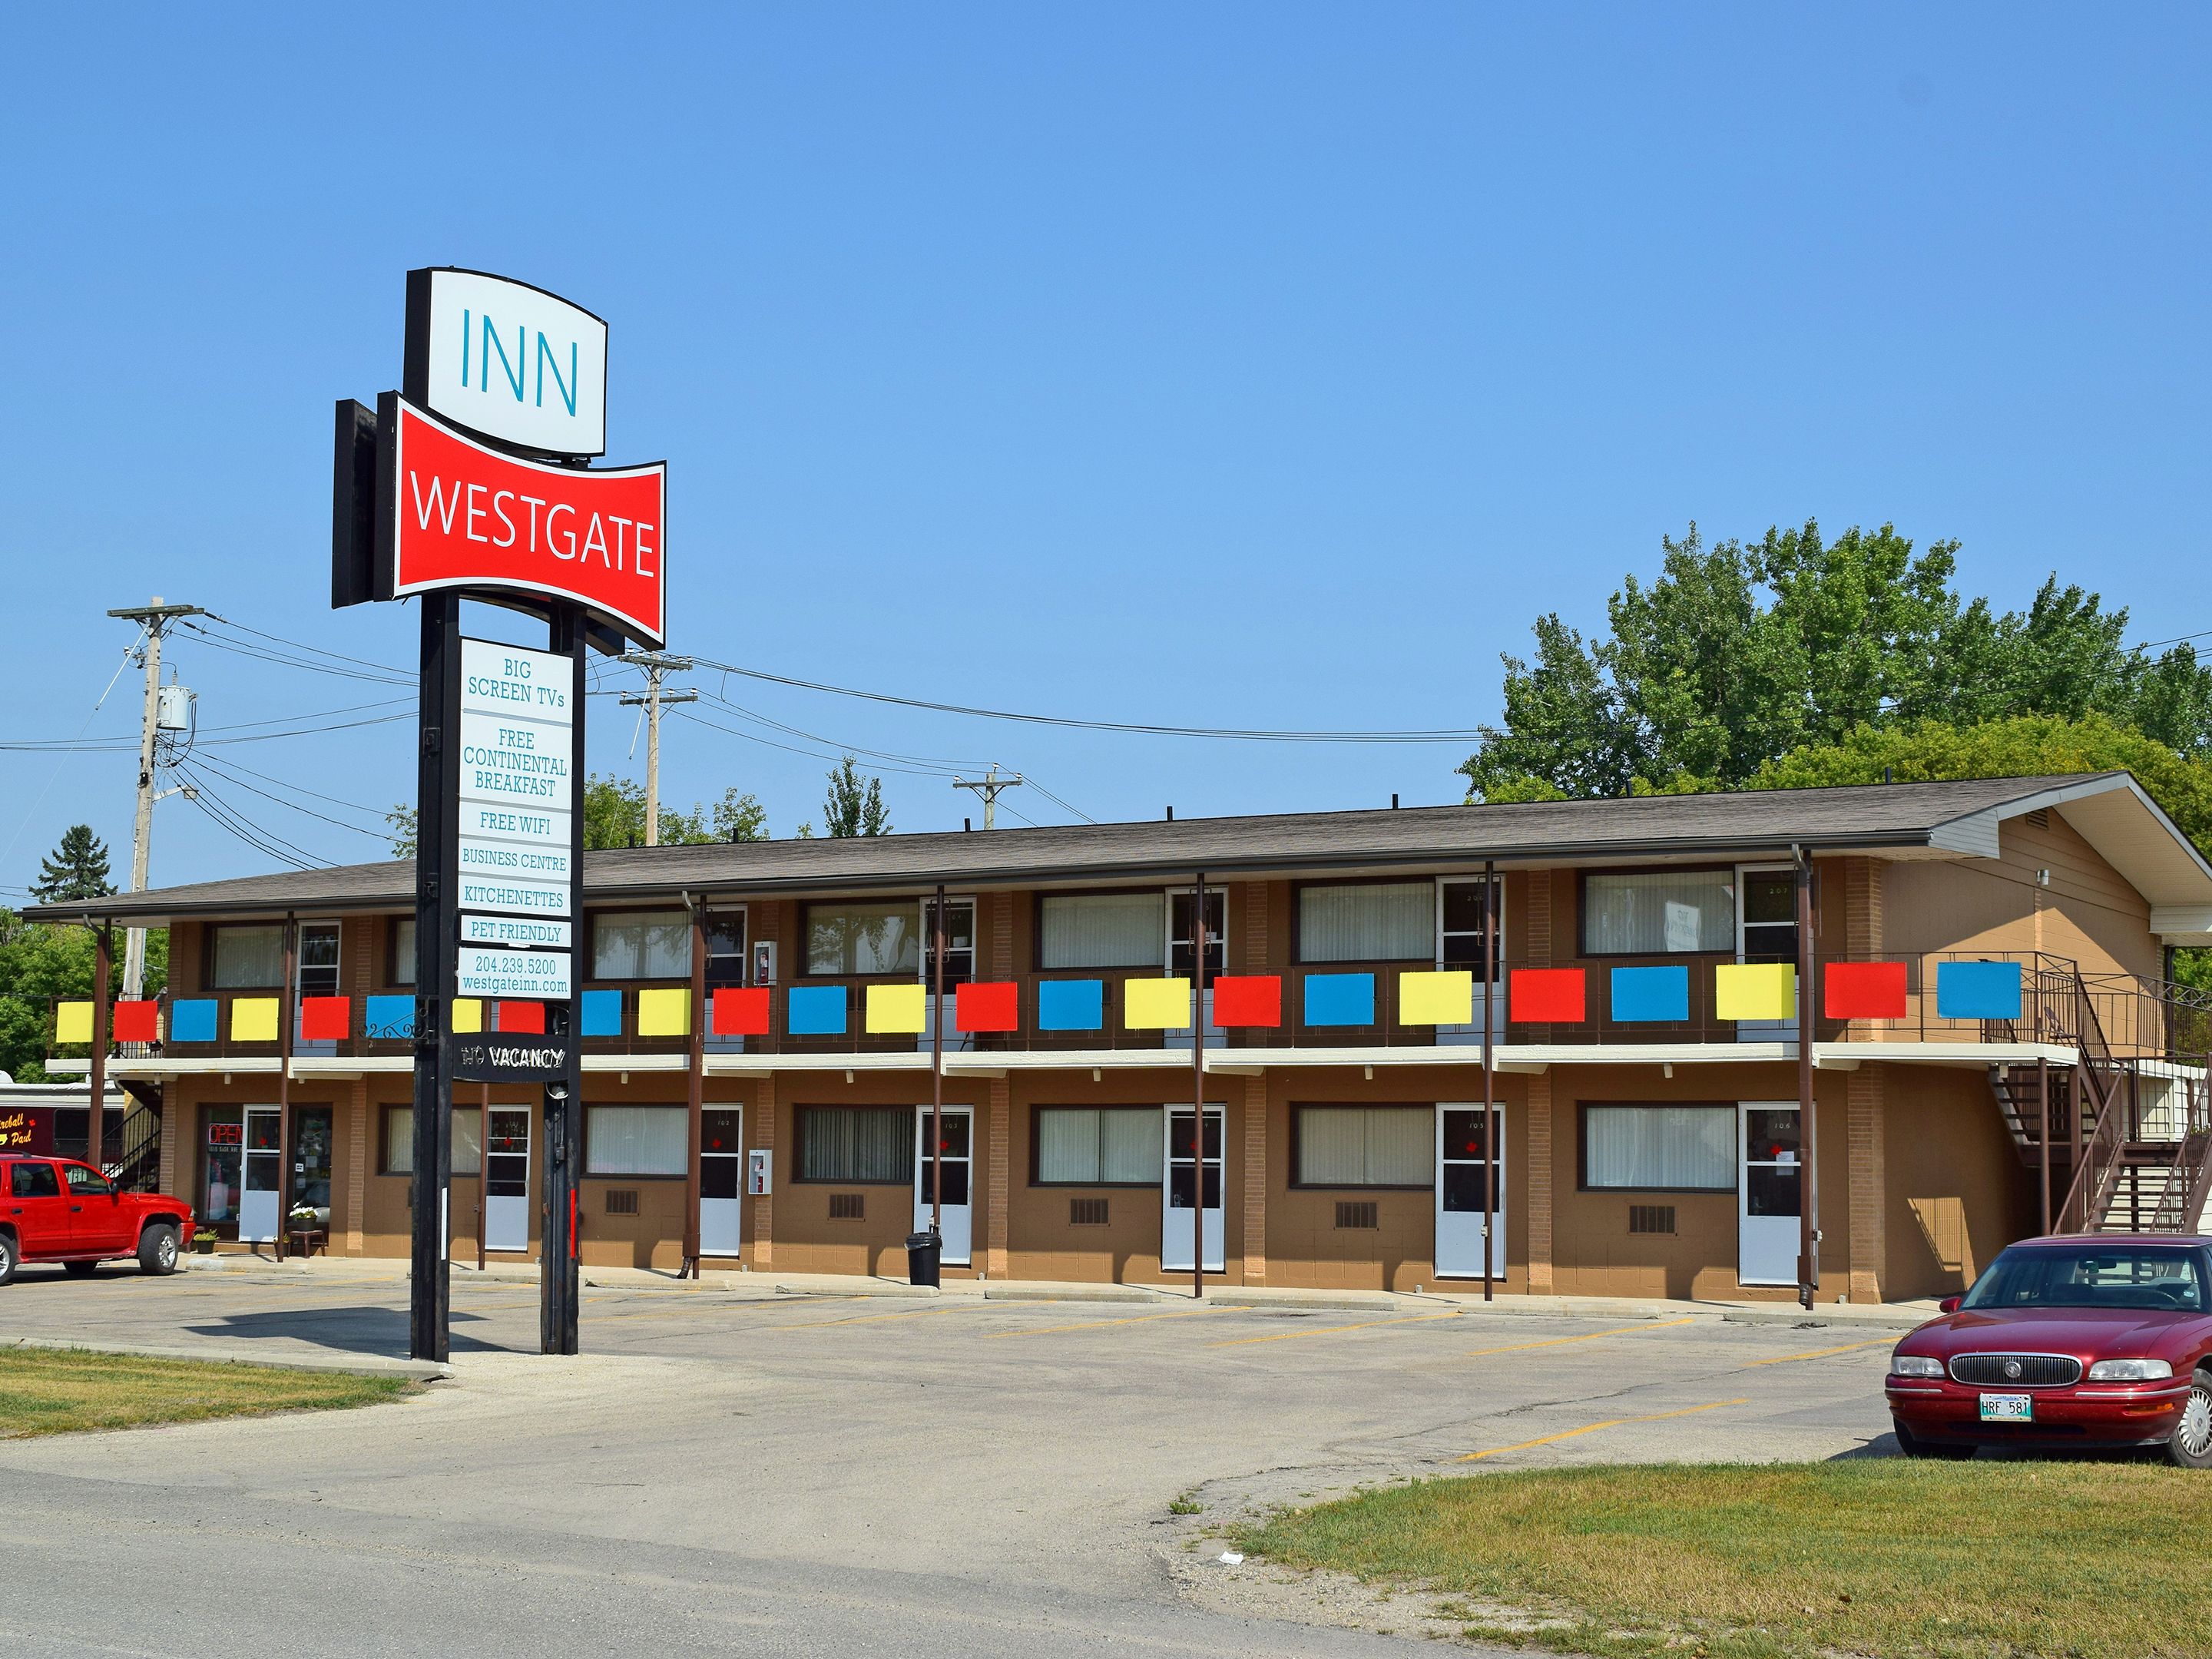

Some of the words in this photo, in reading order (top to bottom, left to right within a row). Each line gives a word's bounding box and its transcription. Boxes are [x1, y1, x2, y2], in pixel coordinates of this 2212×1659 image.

[462, 309, 578, 417] INN
[410, 470, 654, 578] WESTGATE
[504, 658, 531, 679] BIG
[469, 676, 531, 703] SCREEN
[537, 687, 565, 707] TVs
[498, 728, 535, 750] FREE
[463, 747, 567, 777] CONTINENTAL
[475, 770, 555, 797] BREAKFAST
[480, 812, 516, 830] FREE
[519, 816, 551, 835] WIFI
[462, 848, 518, 867] BUSINESS
[521, 854, 567, 872] CENTRE
[464, 886, 564, 909] KITCHENETTES
[471, 921, 496, 938] PET
[499, 923, 561, 942] FRIENDLY
[475, 955, 556, 975] 204.239.5200
[463, 975, 568, 994] westgateinn.com
[460, 1045, 485, 1066] NO
[488, 1045, 566, 1068] VACANCY
[11, 1129, 31, 1146] Paul
[209, 1124, 243, 1144] OPEN
[1982, 1401, 2002, 1413] HRF
[2008, 1402, 2028, 1414] 581
